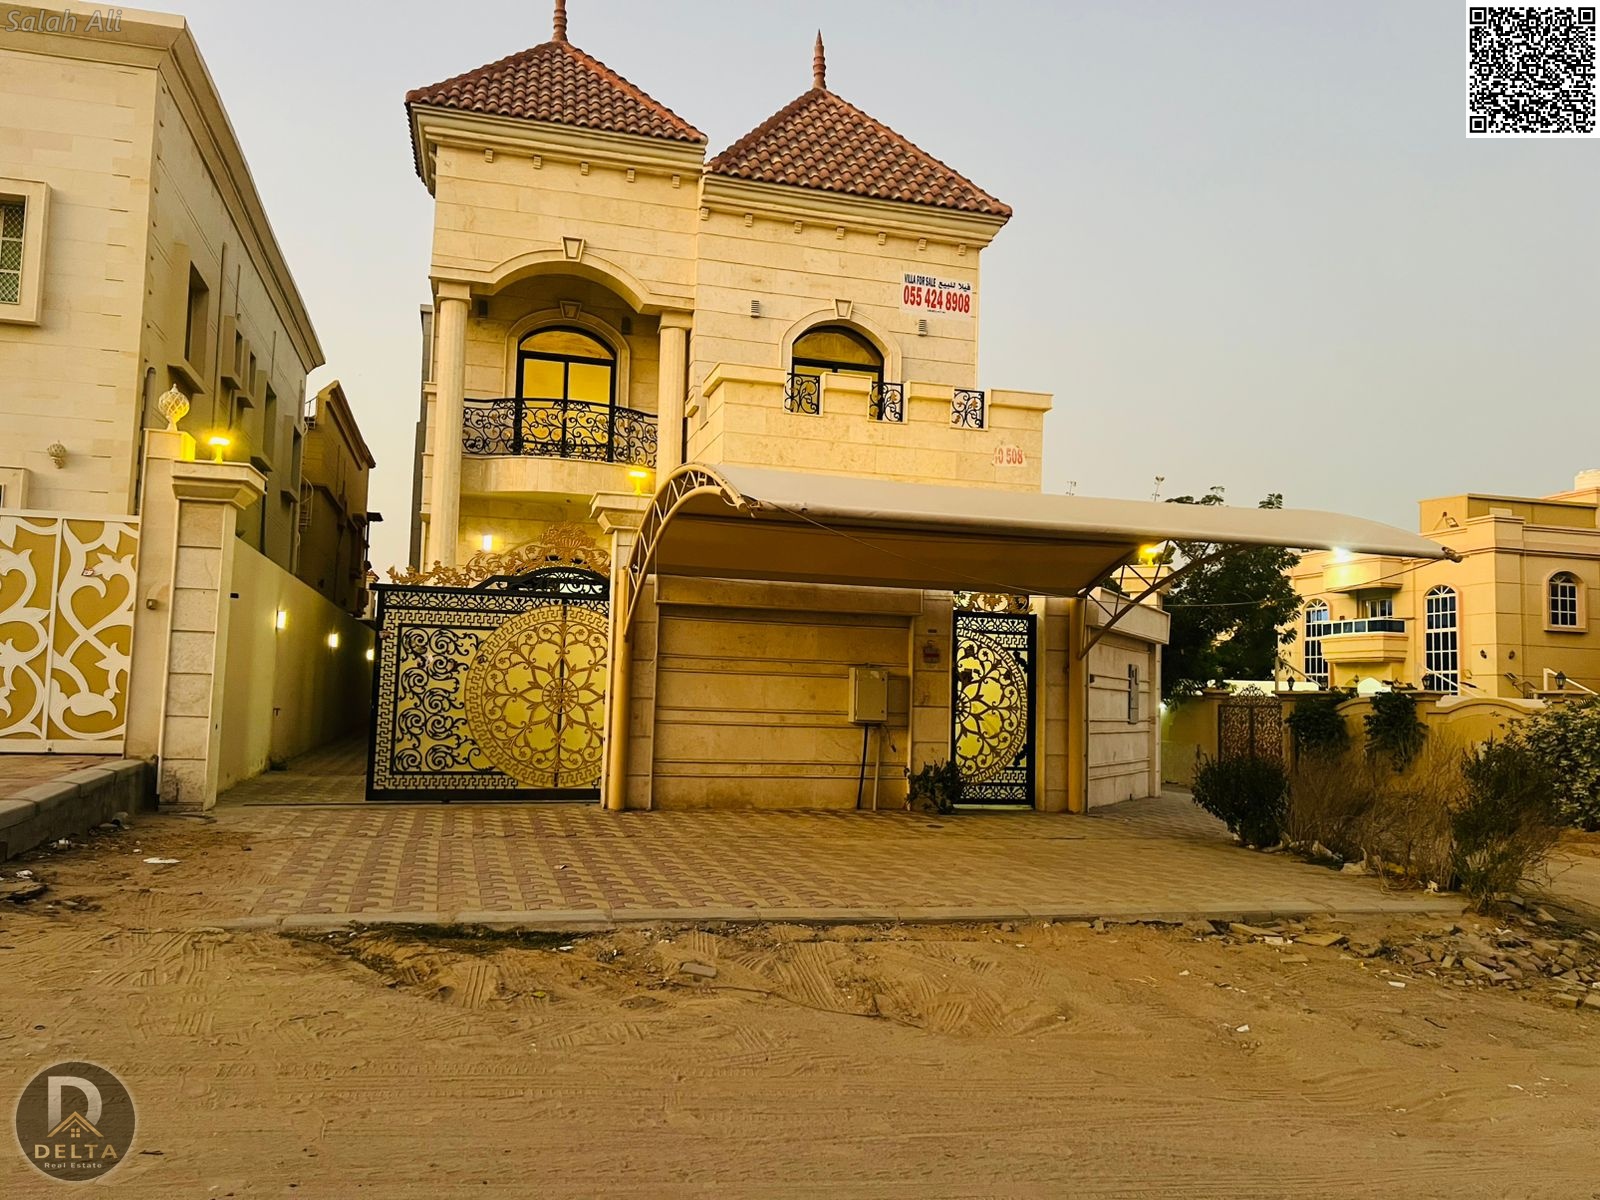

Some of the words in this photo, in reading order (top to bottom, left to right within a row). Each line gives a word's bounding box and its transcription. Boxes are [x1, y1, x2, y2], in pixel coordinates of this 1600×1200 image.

[904, 274, 916, 285] VILLA
[916, 275, 925, 286] FOR
[925, 276, 936, 287] SALE
[903, 285, 922, 306] 055
[924, 288, 943, 310] 424
[945, 291, 971, 313] 8908
[1006, 448, 1023, 464] 508
